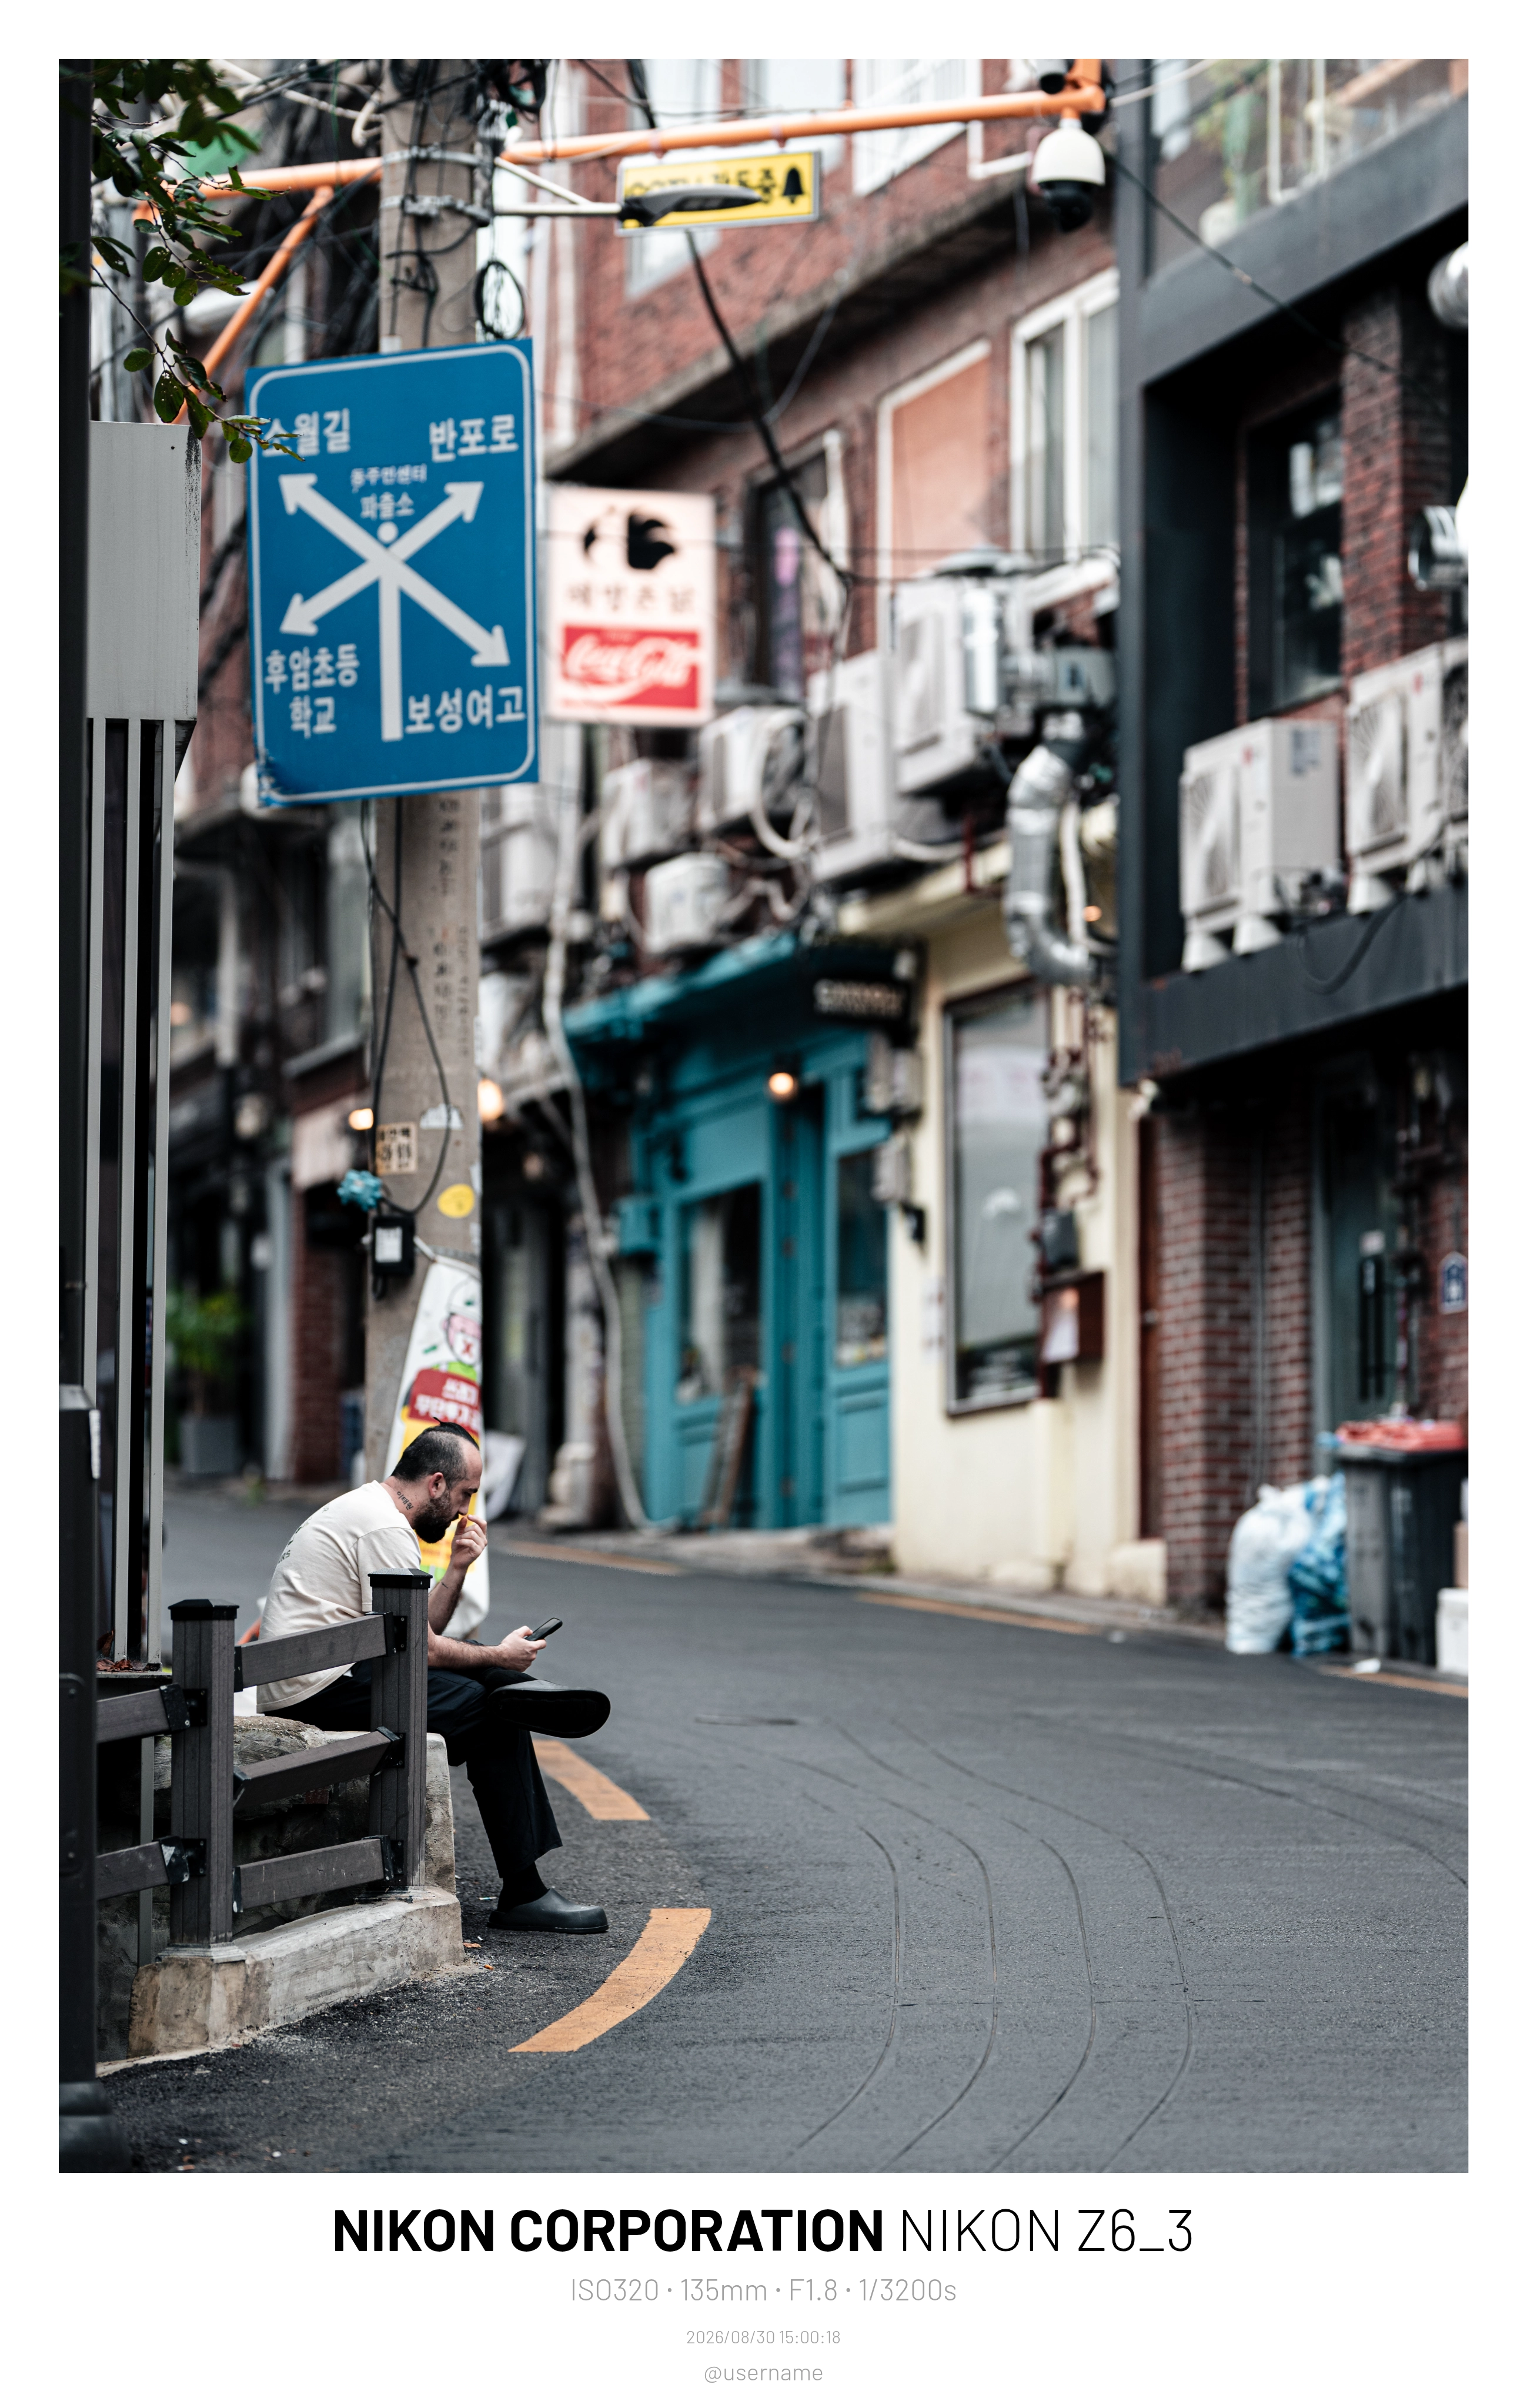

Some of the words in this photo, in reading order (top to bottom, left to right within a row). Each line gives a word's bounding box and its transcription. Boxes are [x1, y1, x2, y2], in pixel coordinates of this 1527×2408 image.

[262, 408, 350, 457] 소월길
[429, 414, 519, 463] 반포로
[360, 492, 415, 520] 파출소
[265, 643, 359, 694] 후암초등
[289, 695, 336, 738] 학교
[405, 684, 525, 734] 보성여고
[397, 1491, 414, 1510] 이태원
